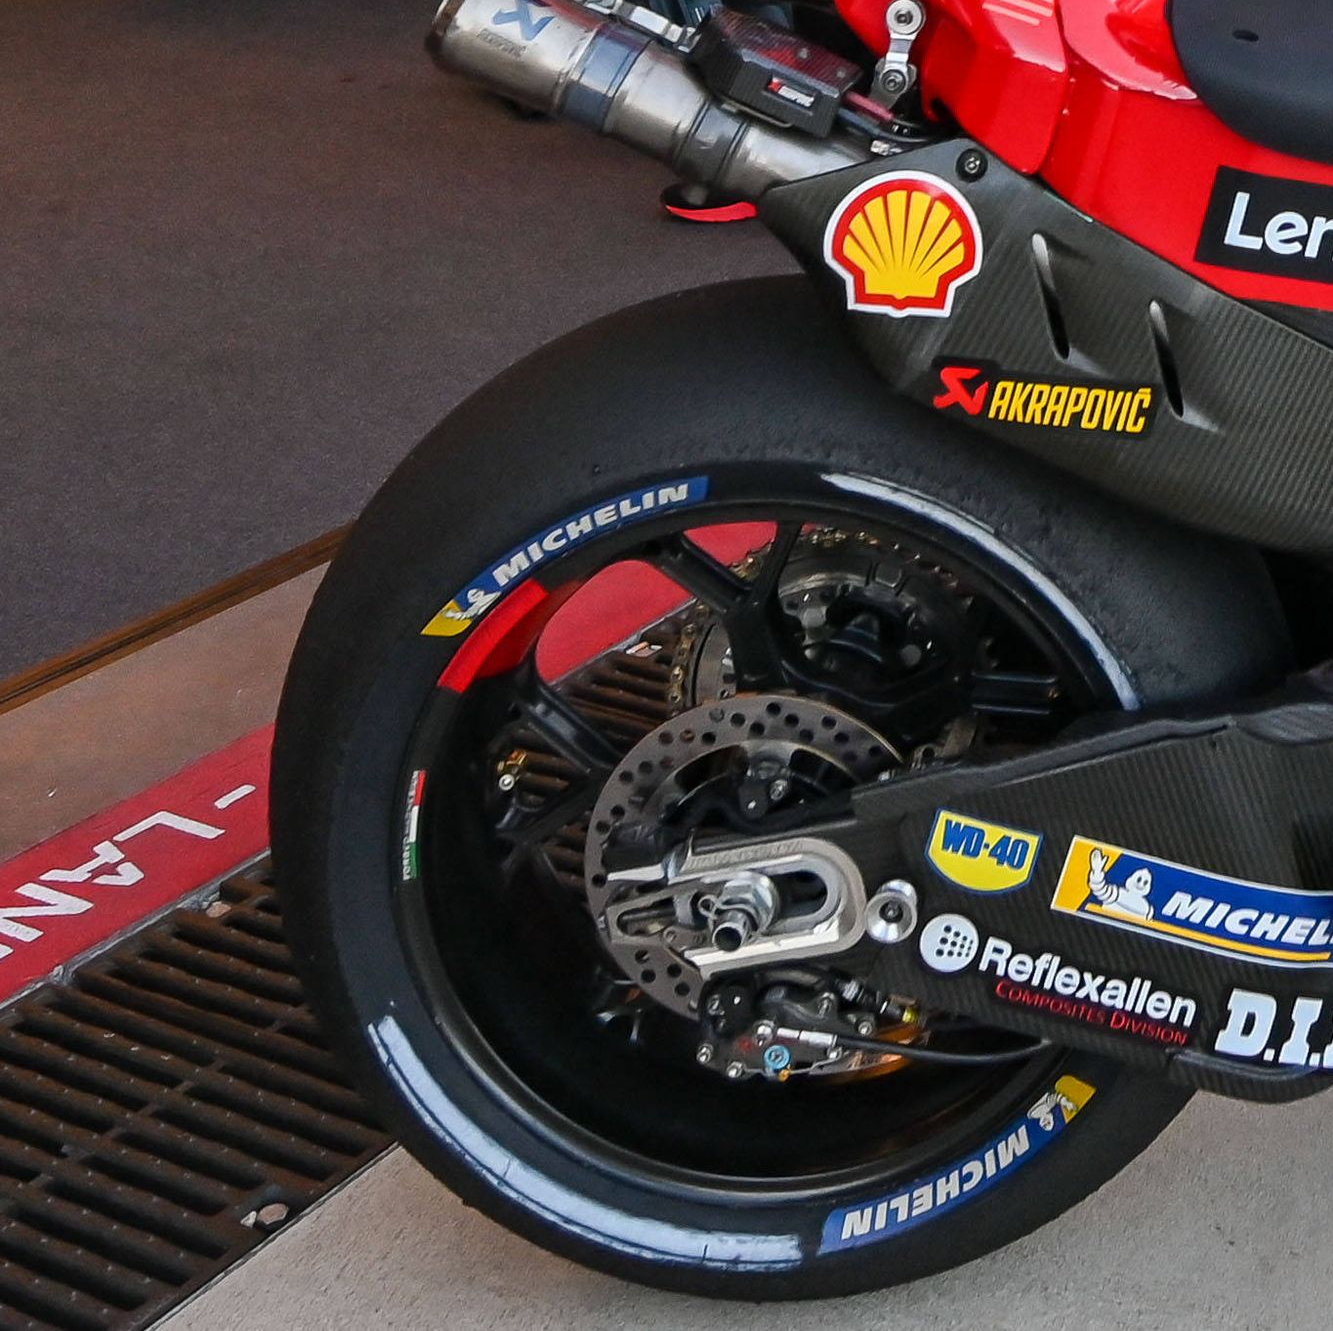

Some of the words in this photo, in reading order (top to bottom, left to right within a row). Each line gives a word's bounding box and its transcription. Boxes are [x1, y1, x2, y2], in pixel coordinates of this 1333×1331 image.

[987, 379, 1152, 434] AKRAPOVIČ
[490, 482, 689, 589] MICHELIN
[0, 809, 226, 962] LAN
[938, 830, 1030, 873] WD-40
[978, 937, 1198, 1025] Reflexallen
[993, 978, 1104, 1031] COMPOSITES
[1108, 1008, 1188, 1045] DIVISION
[840, 1141, 1032, 1241] MICHELIN
